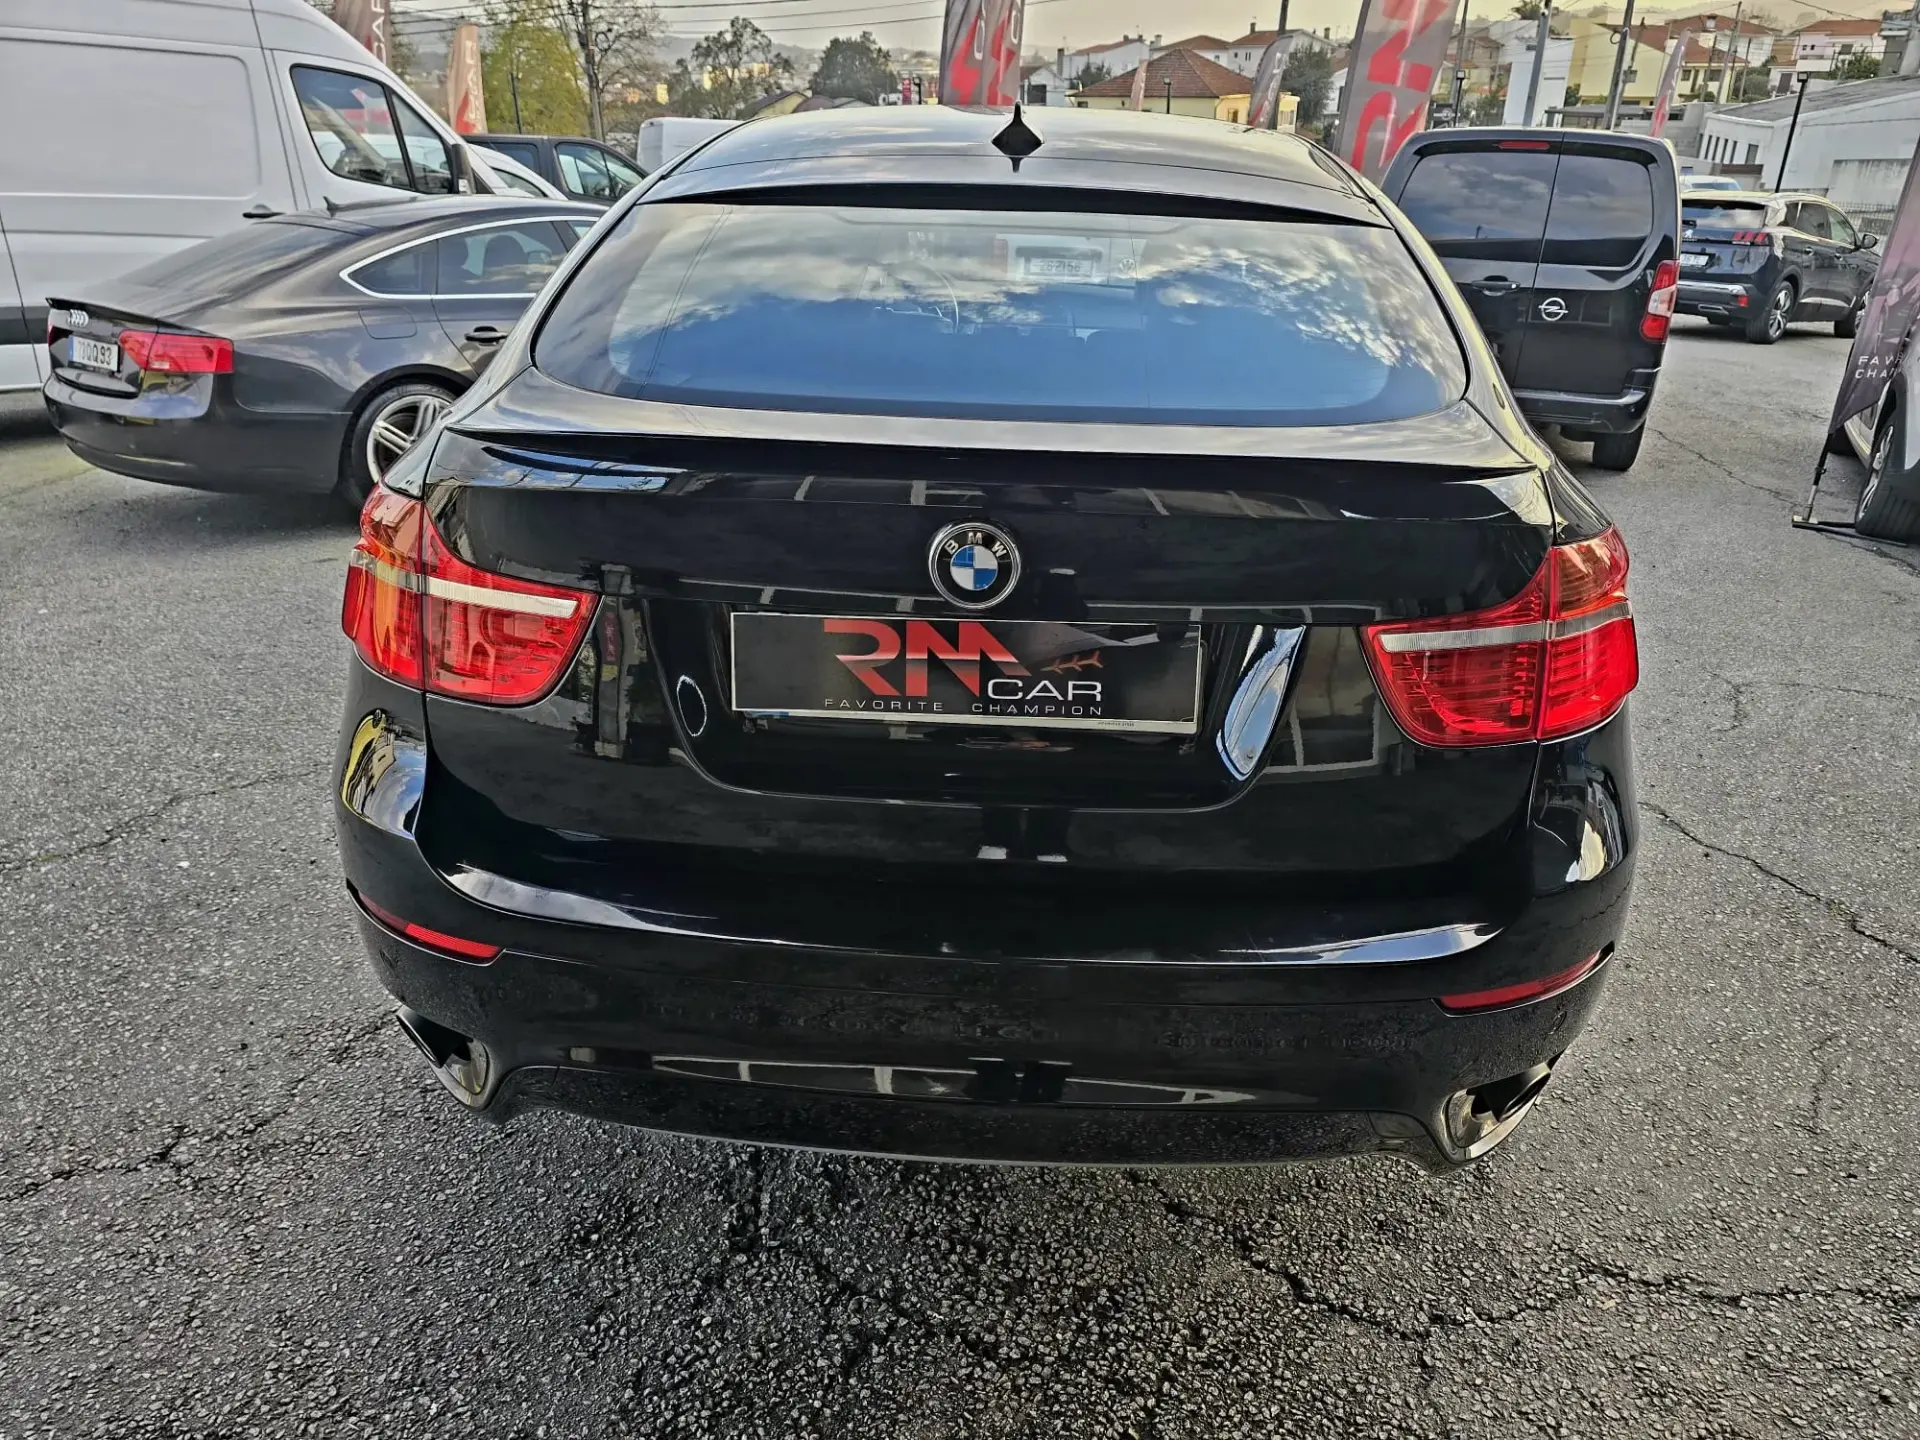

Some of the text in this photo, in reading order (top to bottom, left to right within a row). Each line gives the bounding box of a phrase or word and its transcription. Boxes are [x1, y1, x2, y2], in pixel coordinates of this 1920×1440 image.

[944, 531, 1007, 558] BMW
[987, 679, 1102, 701] CAR
[824, 698, 1102, 715] FAVORITE CHAMPION
